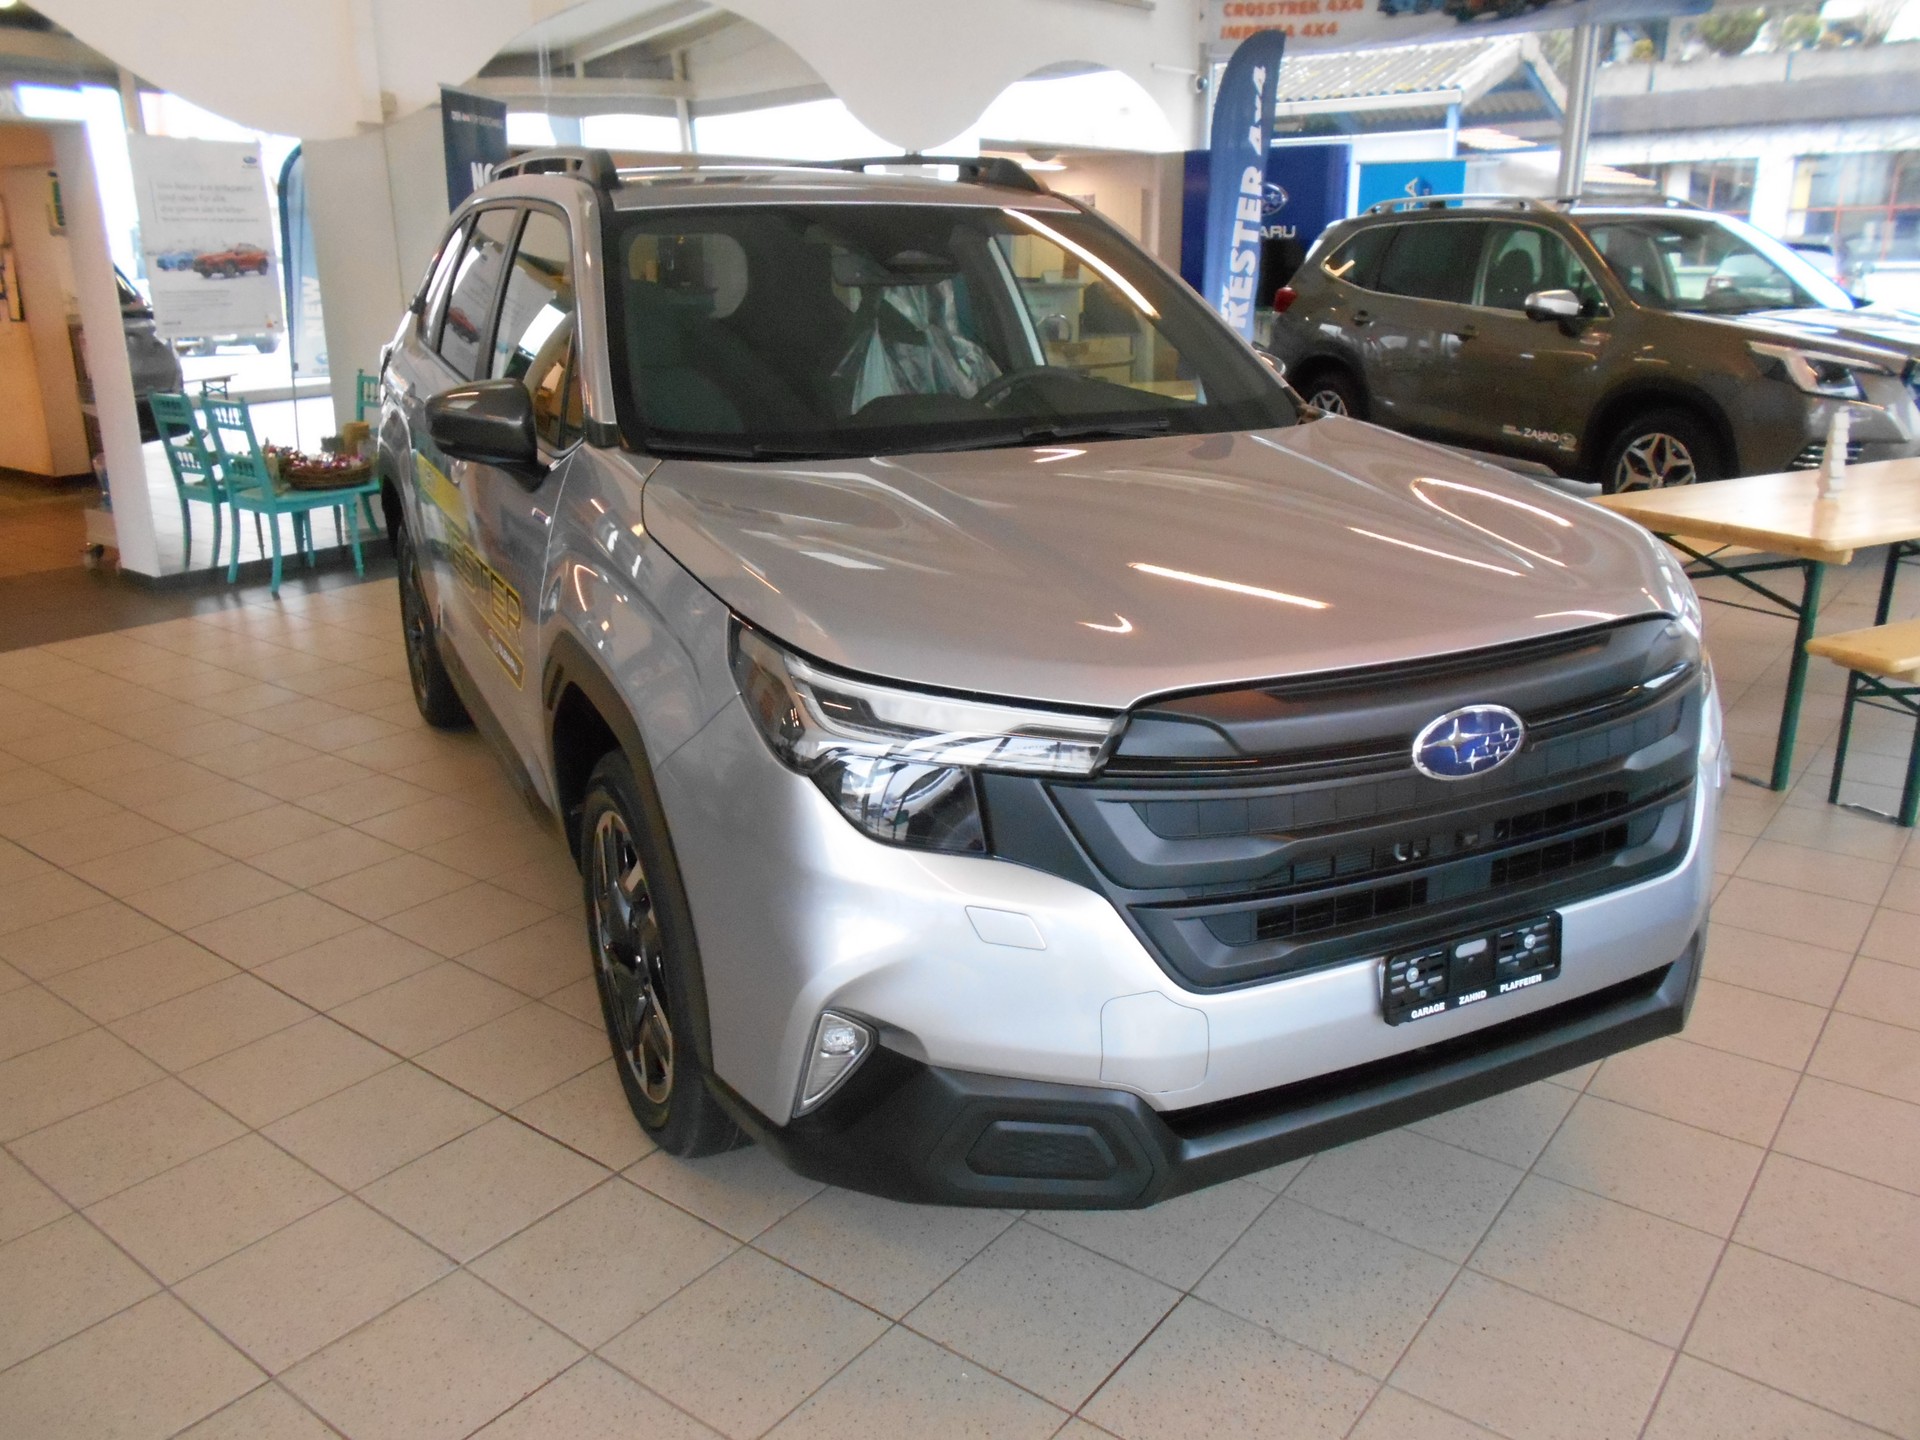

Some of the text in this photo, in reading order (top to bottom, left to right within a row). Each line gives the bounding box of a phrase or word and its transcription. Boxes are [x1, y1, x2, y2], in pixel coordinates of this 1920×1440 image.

[1223, 0, 1320, 17] CROSSTREK
[1220, 21, 1340, 40] IMPA 4X4
[1259, 224, 1297, 239] ARU
[1411, 974, 1542, 1019] GARAGE ZAHND PLAFFEIEN
